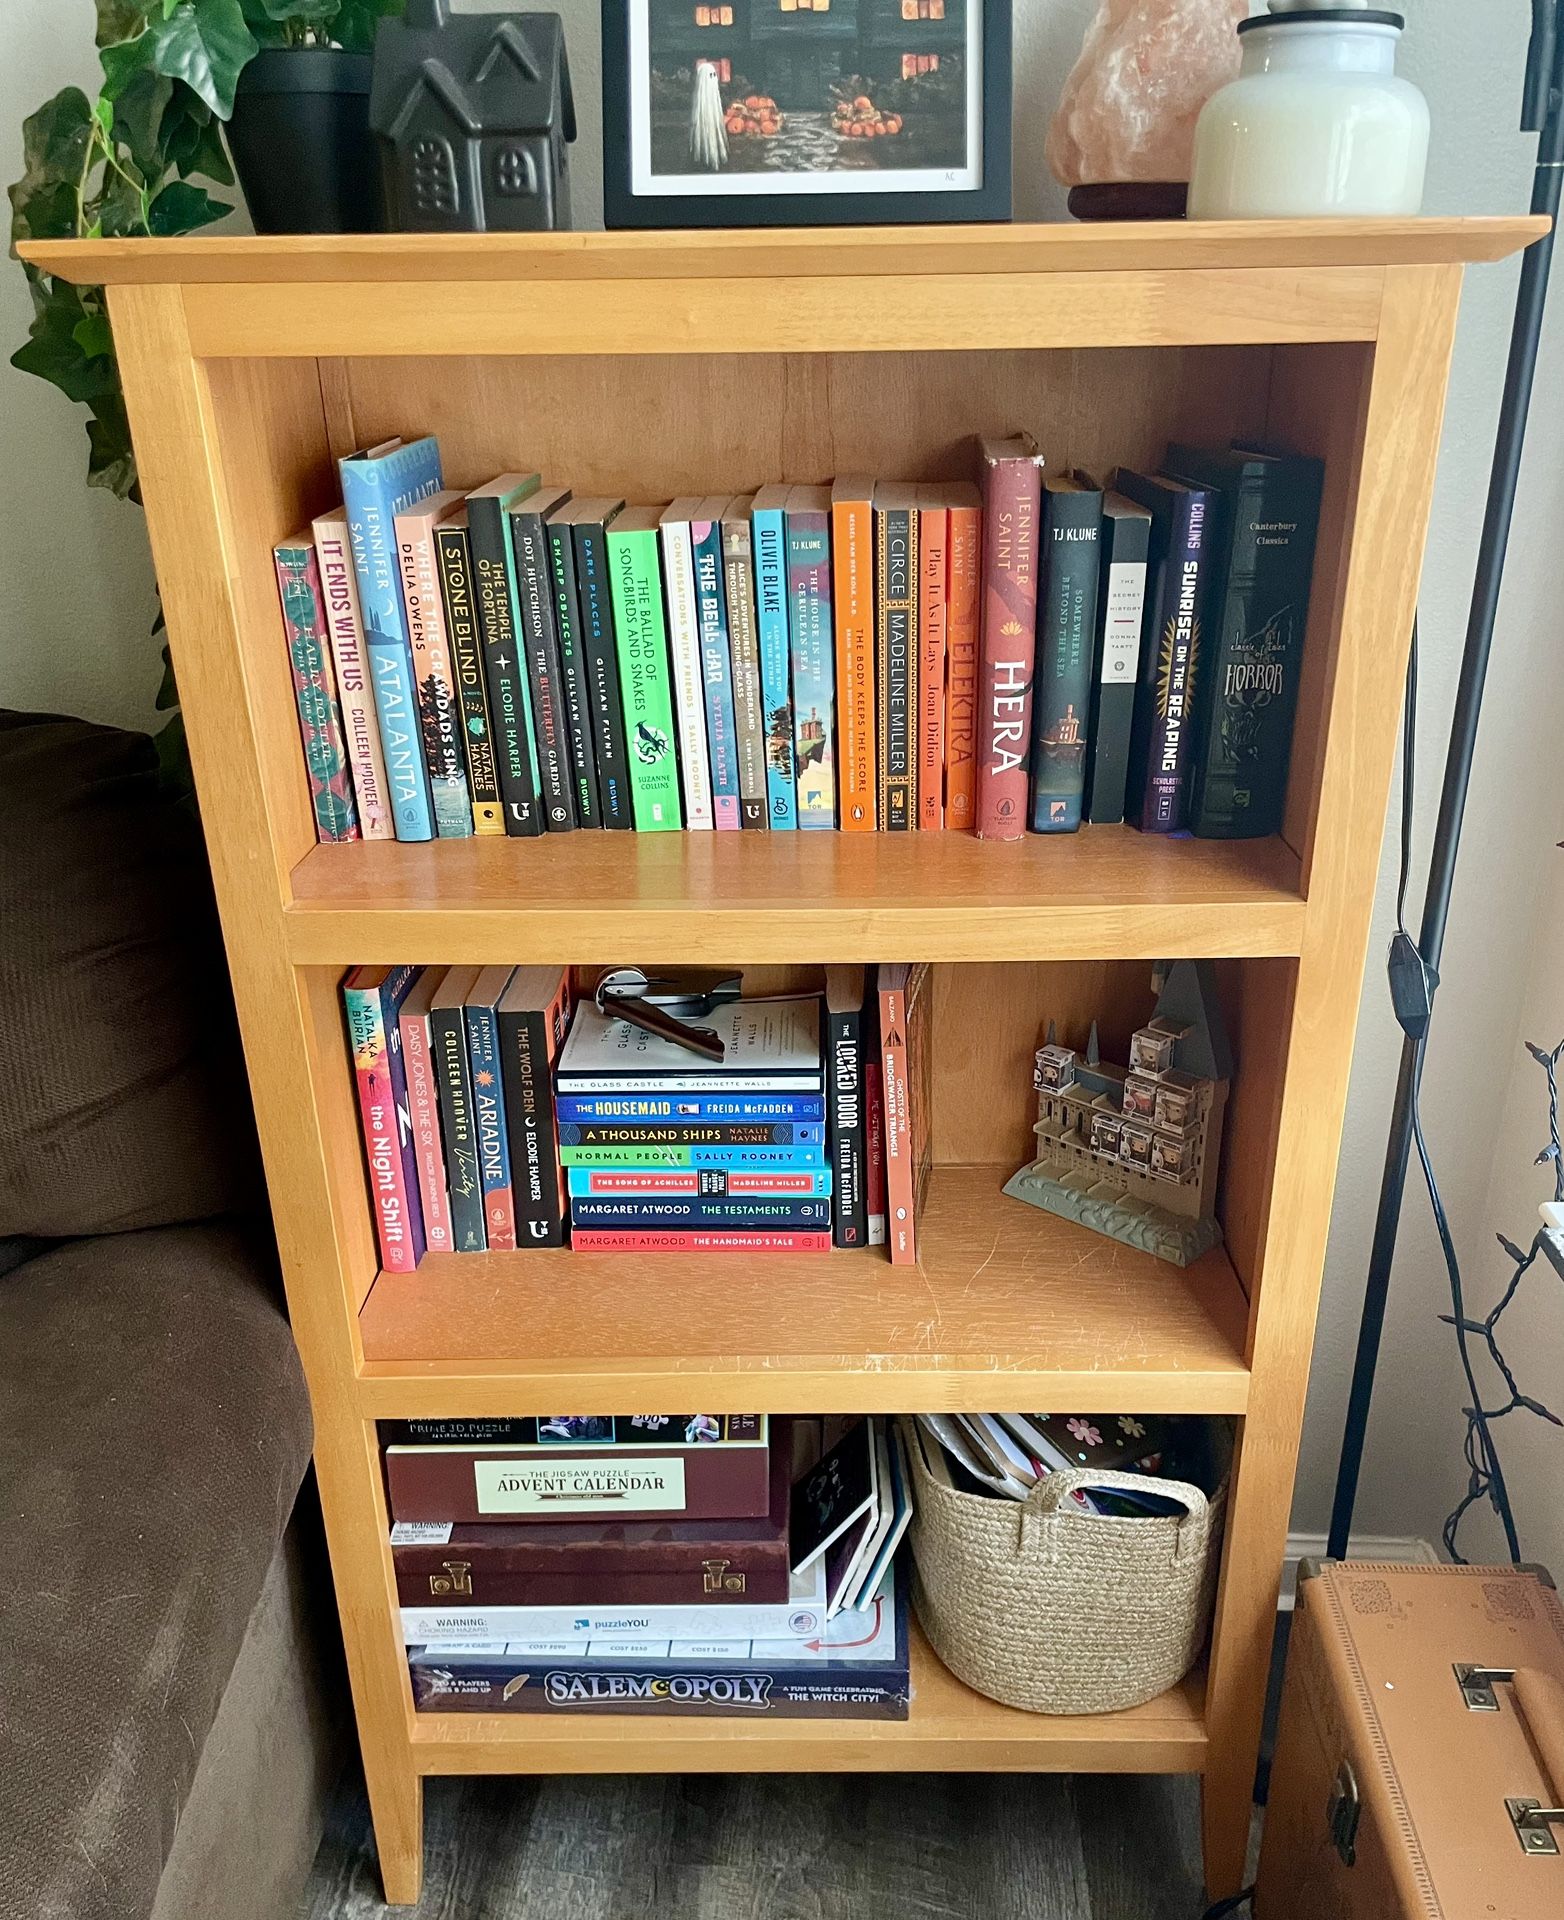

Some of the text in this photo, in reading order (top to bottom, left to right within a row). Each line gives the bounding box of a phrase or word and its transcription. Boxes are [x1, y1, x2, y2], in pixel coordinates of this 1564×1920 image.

[351, 523, 370, 574] SAINT
[363, 506, 389, 590] JENNIFER
[792, 541, 821, 550] TJ KLUNE
[997, 513, 1012, 570] SAINT
[1015, 496, 1032, 586] JENNIFER
[1054, 528, 1098, 541] TJ KLUNE
[1188, 503, 1205, 549] COLLINS
[1250, 522, 1297, 532] Canterbury
[1256, 537, 1288, 545] Classics
[699, 554, 716, 592] THE
[760, 530, 780, 613] OLIVIE BLAKE
[891, 539, 905, 594] CIRCE
[955, 537, 964, 576] SAINT
[402, 544, 426, 650] DELIA OWENS
[478, 560, 498, 645] OF FORTUNA
[492, 562, 512, 640] THE TEMPLE
[524, 537, 542, 638] DOT HUTCHISON
[553, 539, 572, 656] SHARP OBJECTS
[322, 540, 363, 691] IT ENDS WITH US
[446, 548, 477, 685] STONE BLIND
[620, 548, 646, 711] SONGBIRDS AND SNAKES
[637, 577, 657, 681] THE BALLAD OF
[702, 598, 720, 643] BELL
[798, 582, 809, 671] CERULEAN SEA
[810, 569, 821, 682] THE HOUSE IN THE
[1071, 589, 1083, 666] SOMEWHERE
[706, 650, 723, 685] JAR
[856, 656, 865, 686] BODY
[1162, 561, 1198, 771] SUNRISE ON THE REAPING
[1224, 664, 1283, 695] HORROR
[568, 668, 585, 767] GILLIAN FLYNN
[891, 615, 905, 771] MADELINE MILLER
[951, 642, 974, 766] ELEKTRA
[991, 660, 1026, 776] HERA
[376, 656, 417, 803] ATALANTA
[500, 679, 521, 778] ELODIE HARPER
[713, 695, 728, 786] SYLVIA PLATH
[927, 684, 939, 767] Joan Didion
[470, 744, 484, 790] HAYNES
[480, 743, 494, 791] NATALIE
[638, 774, 670, 783] SUZANNE
[352, 1010, 367, 1054] BURIAN
[362, 1005, 378, 1058] NATALKA
[471, 1025, 480, 1055] SAINT
[480, 1016, 492, 1061] JENNIFER
[518, 1027, 535, 1113] THE WOLF DEN
[836, 1040, 857, 1090] LOCKED
[596, 1102, 671, 1115] HOUSEMAID
[707, 1104, 793, 1113] FREIDA McFADDEN
[838, 1094, 858, 1129] DOOR
[886, 1054, 898, 1157] BRIDGEWATER TRIANGLE
[898, 1109, 904, 1118] OF
[478, 1094, 503, 1180] ARIADNE
[586, 1130, 720, 1140] A THOUSAND SHIPS
[370, 1105, 401, 1242] the Night Shift
[454, 1148, 475, 1198] Verity
[526, 1131, 541, 1201] ELODIE HARPER
[579, 1205, 690, 1214] MARGARET ATWOOD
[702, 1206, 791, 1215] THE TESTAMENTS
[410, 1424, 511, 1433] PRIME 3D PUZZLE
[498, 1477, 665, 1492] ADVENT CALENDAR
[595, 1620, 649, 1629] puzzleYOU
[788, 1693, 880, 1702] THE WITCH CITY!
